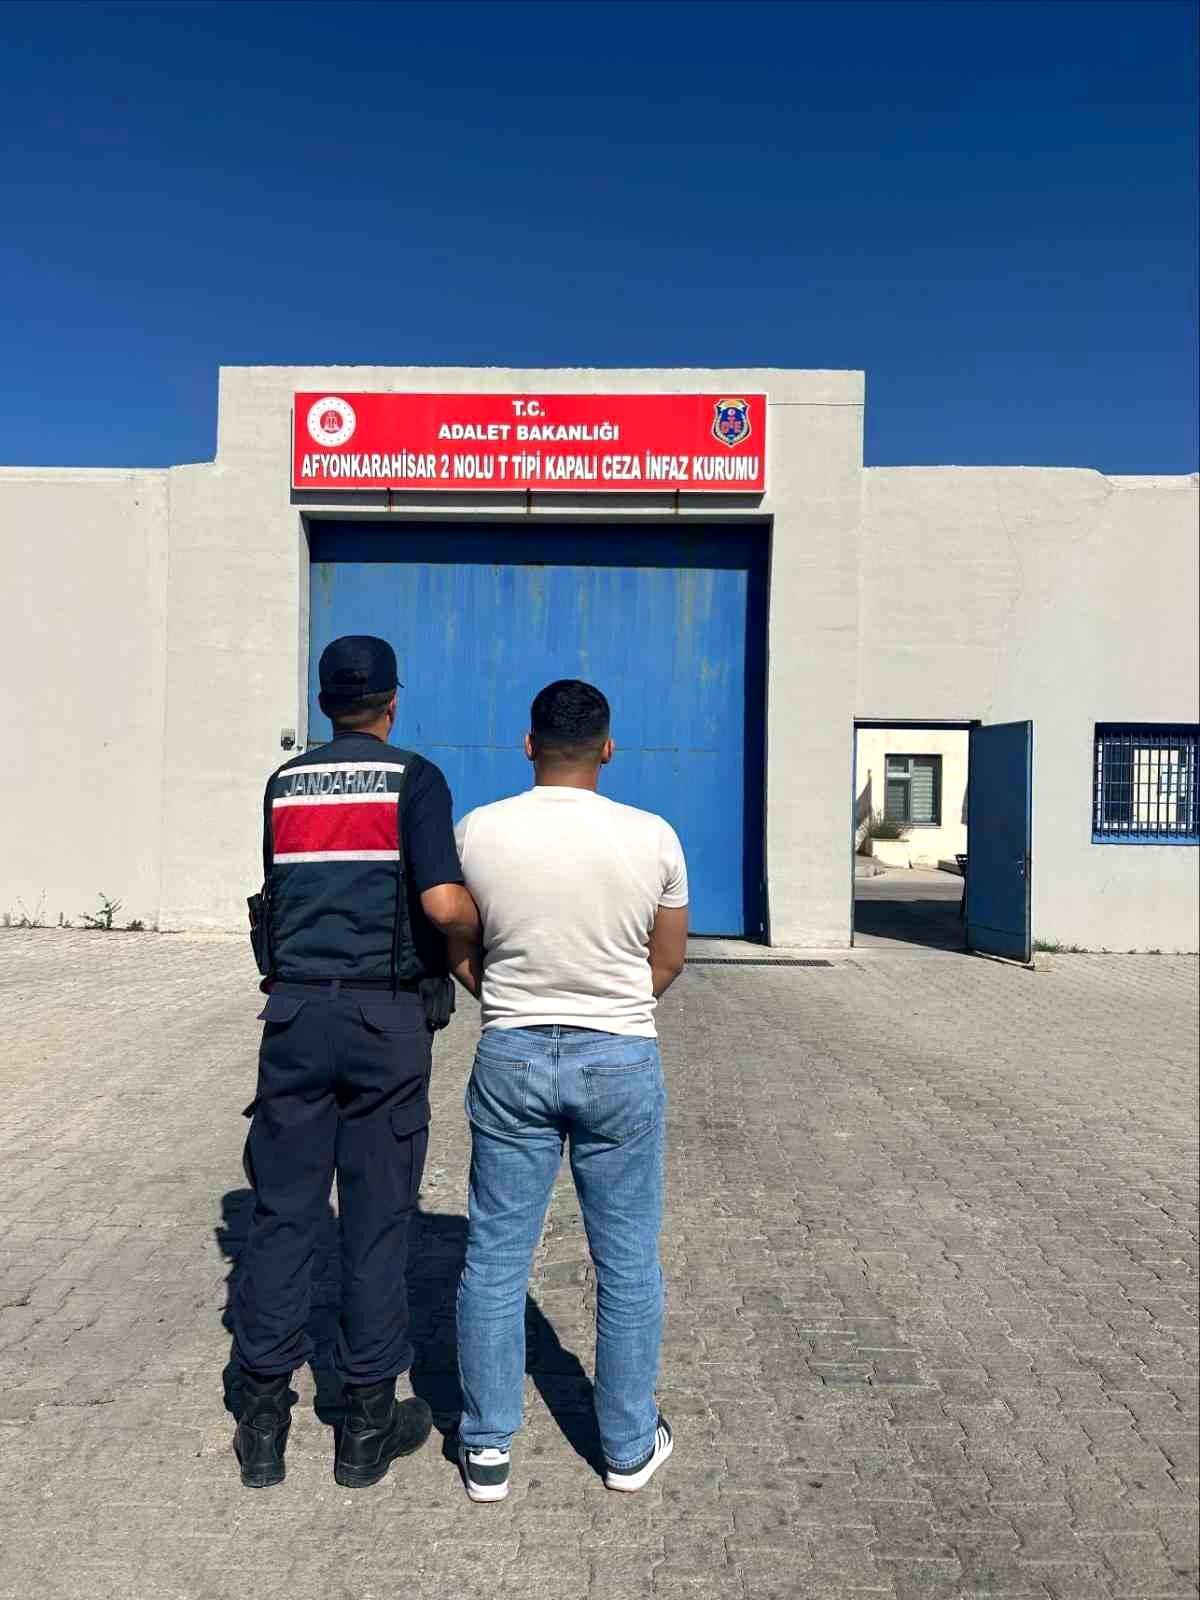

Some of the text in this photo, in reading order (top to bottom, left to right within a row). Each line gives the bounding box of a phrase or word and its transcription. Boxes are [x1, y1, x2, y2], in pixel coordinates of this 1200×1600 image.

[512, 400, 546, 417] T.C.
[437, 422, 620, 441] ADALET BAKANLIĞI
[301, 449, 759, 481] AFYONKARAHİSAR 2 NOLU T TİPİ KAPALI CEZA İNFAZ KURUMU
[284, 769, 388, 796] JANDARMA
